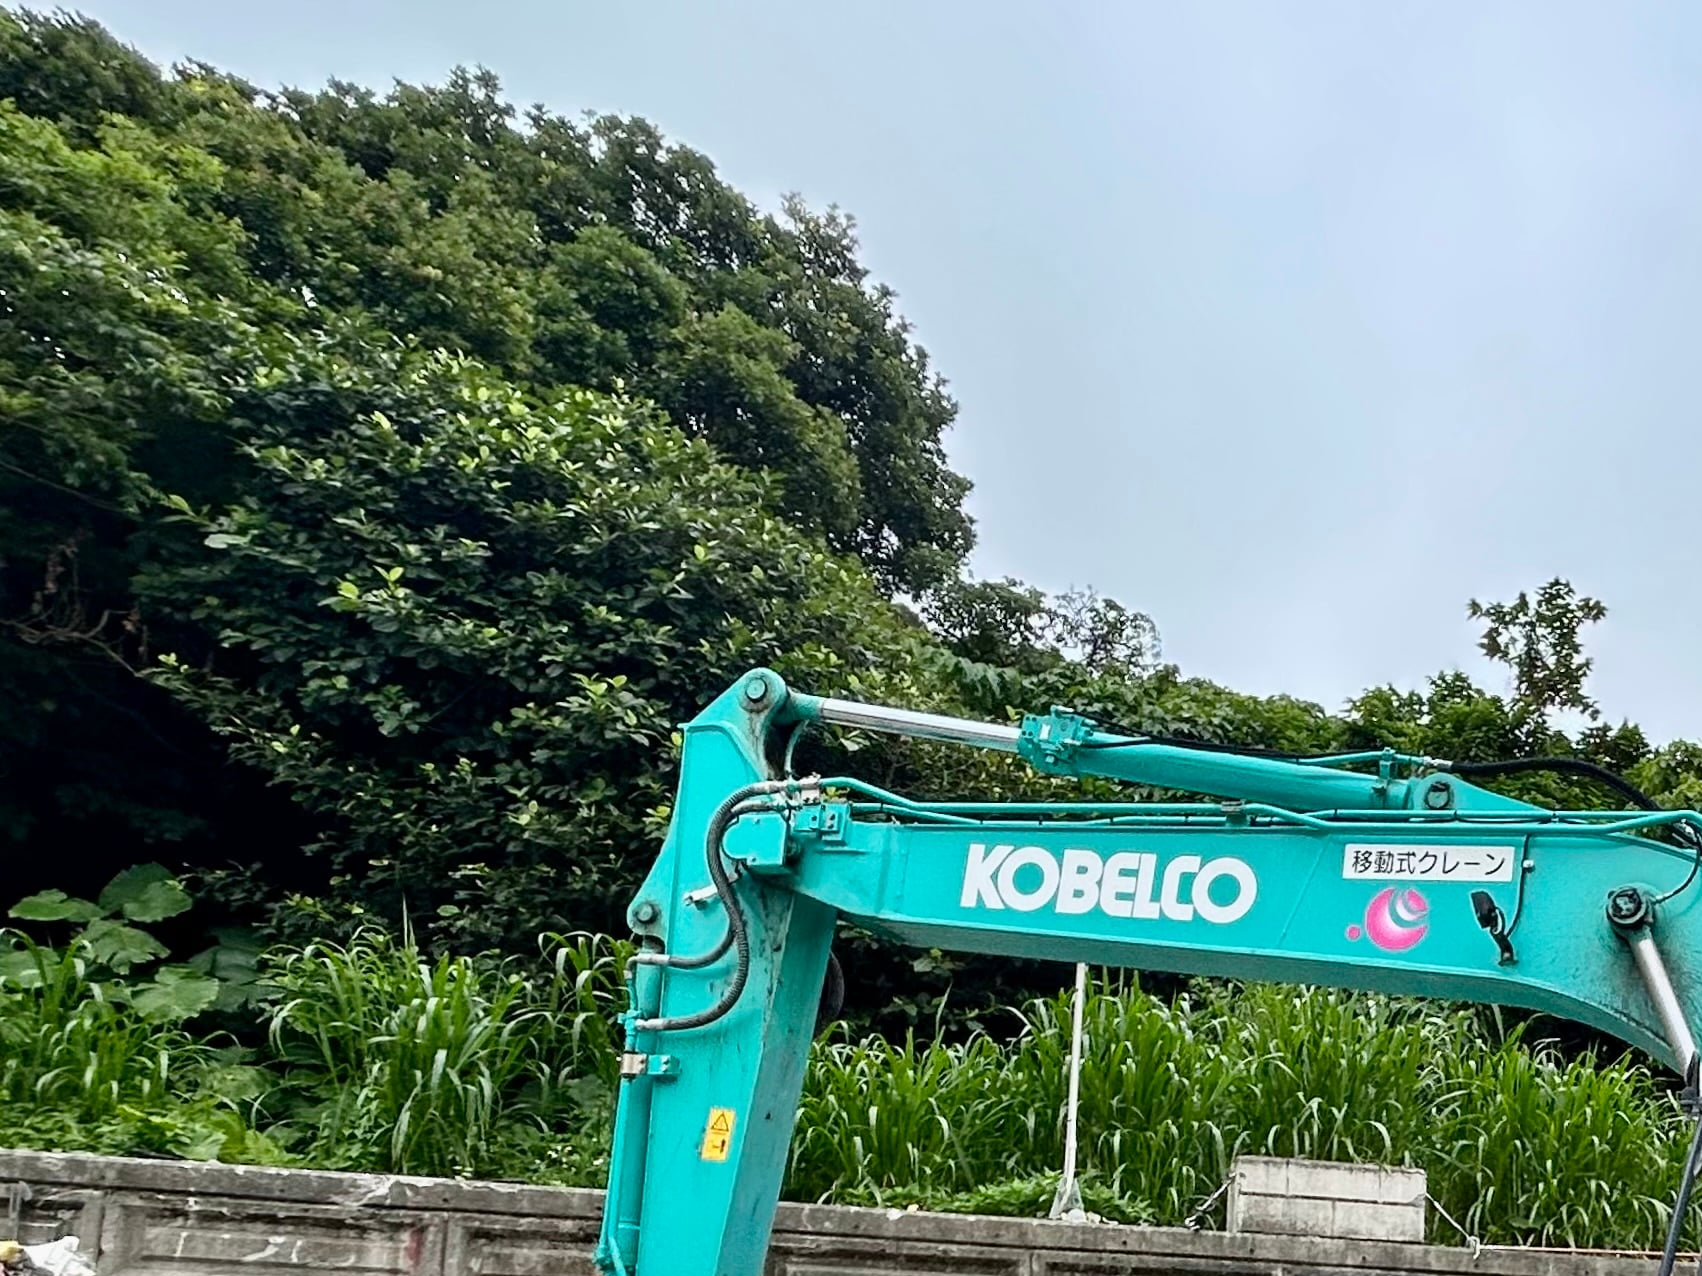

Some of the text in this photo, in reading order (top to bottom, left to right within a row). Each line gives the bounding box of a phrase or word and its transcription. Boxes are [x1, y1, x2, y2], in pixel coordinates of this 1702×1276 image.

[960, 843, 1258, 924] KOBELCO
[1352, 850, 1506, 875] 移動式クレーン
